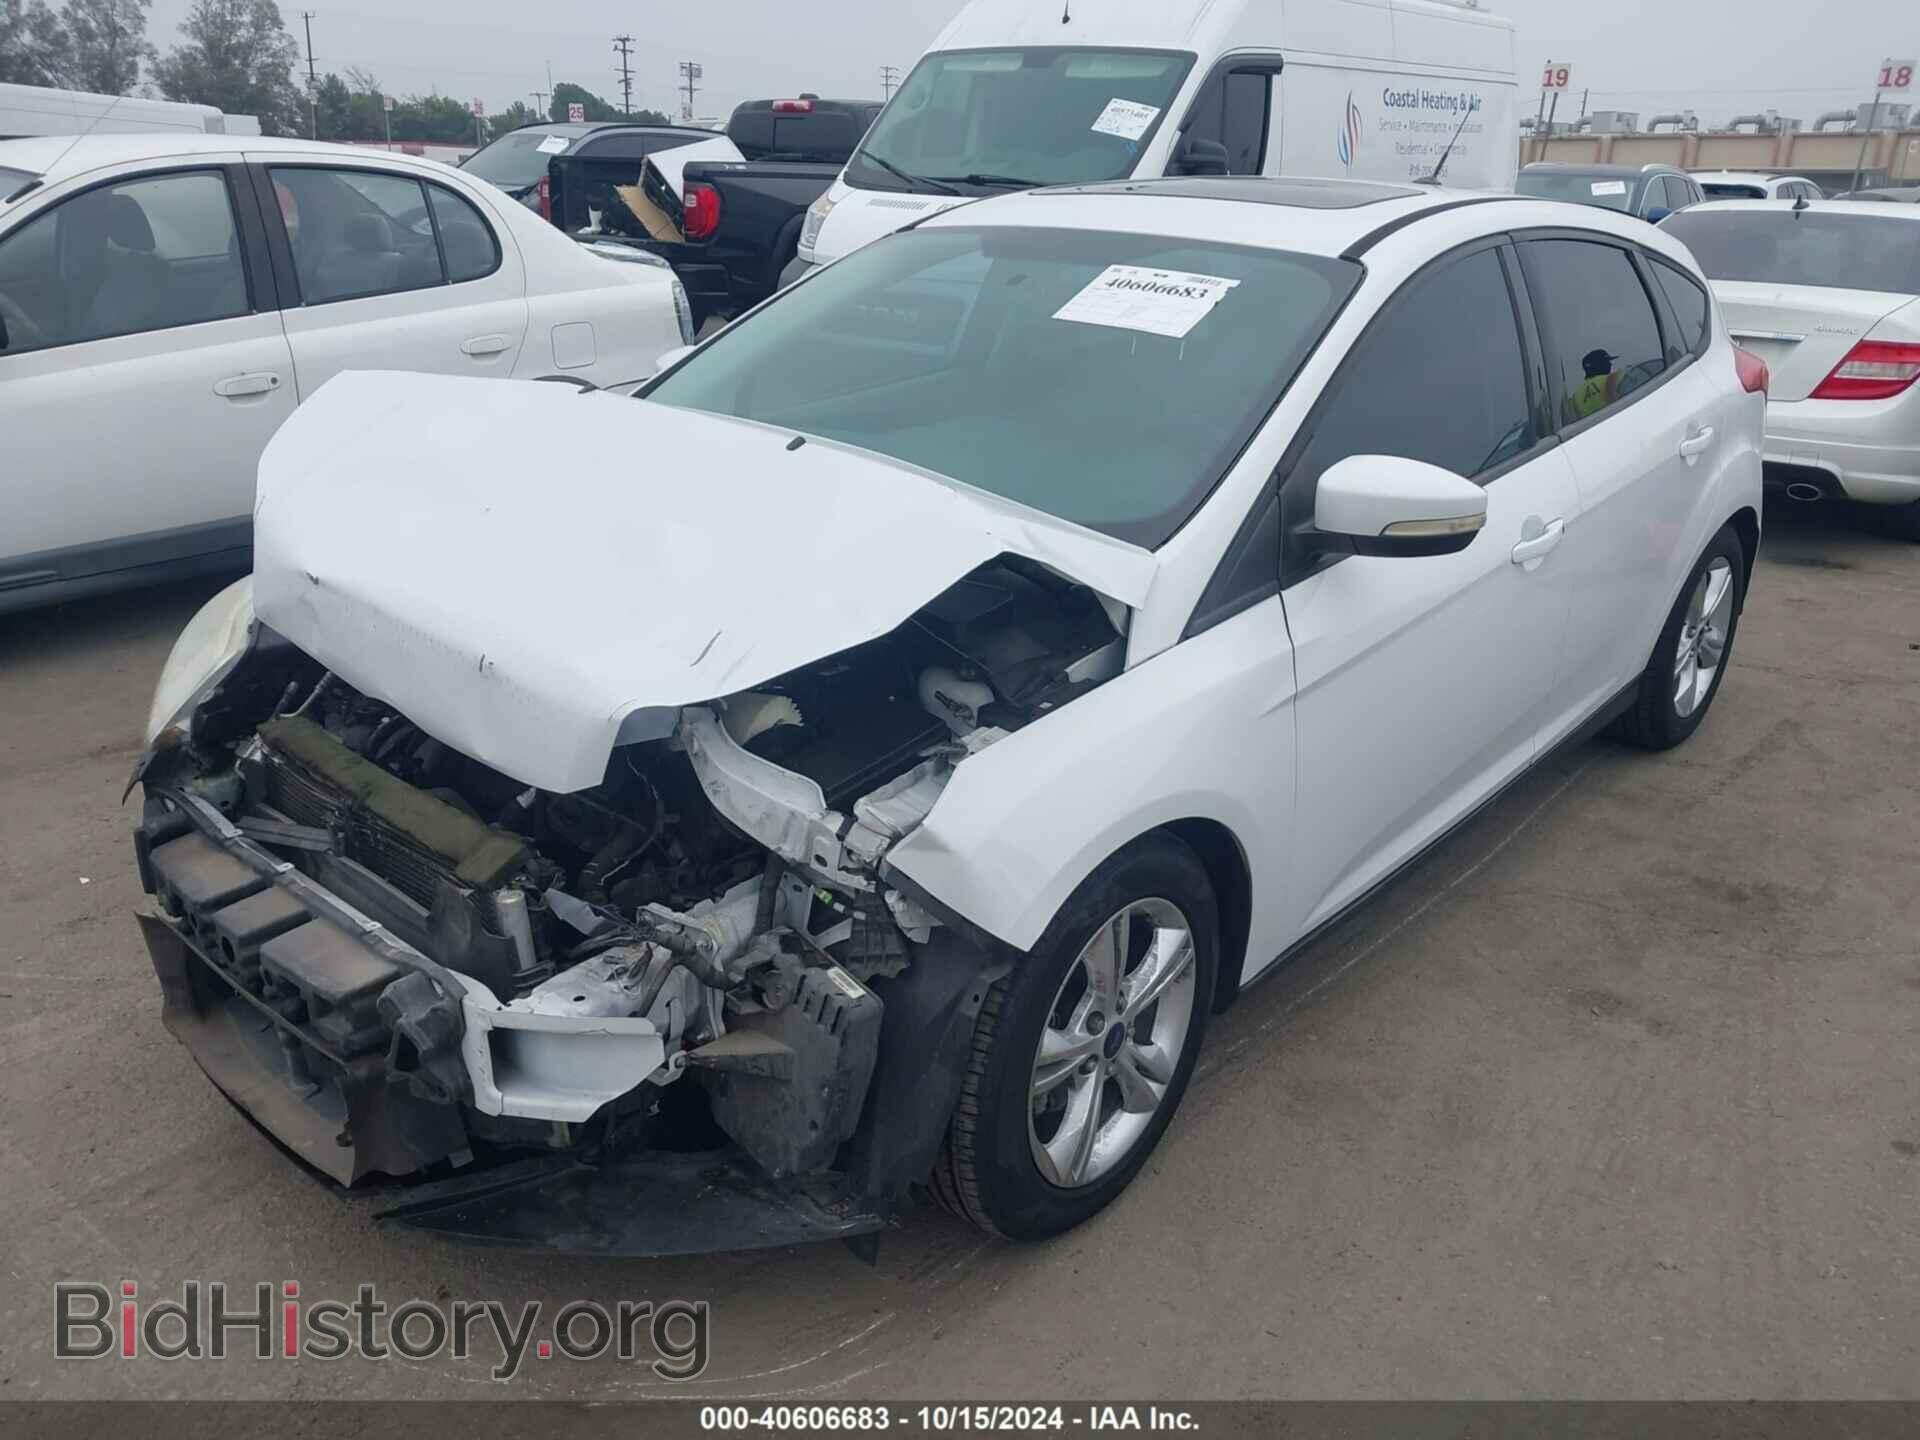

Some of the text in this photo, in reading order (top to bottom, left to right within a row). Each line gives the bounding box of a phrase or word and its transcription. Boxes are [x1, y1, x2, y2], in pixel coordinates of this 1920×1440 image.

[1542, 68, 1569, 87] 19
[1877, 66, 1912, 88] 18
[570, 106, 583, 119] 25
[1383, 87, 1483, 116] Coastal Heating & Air
[1104, 277, 1209, 300] 40606683
